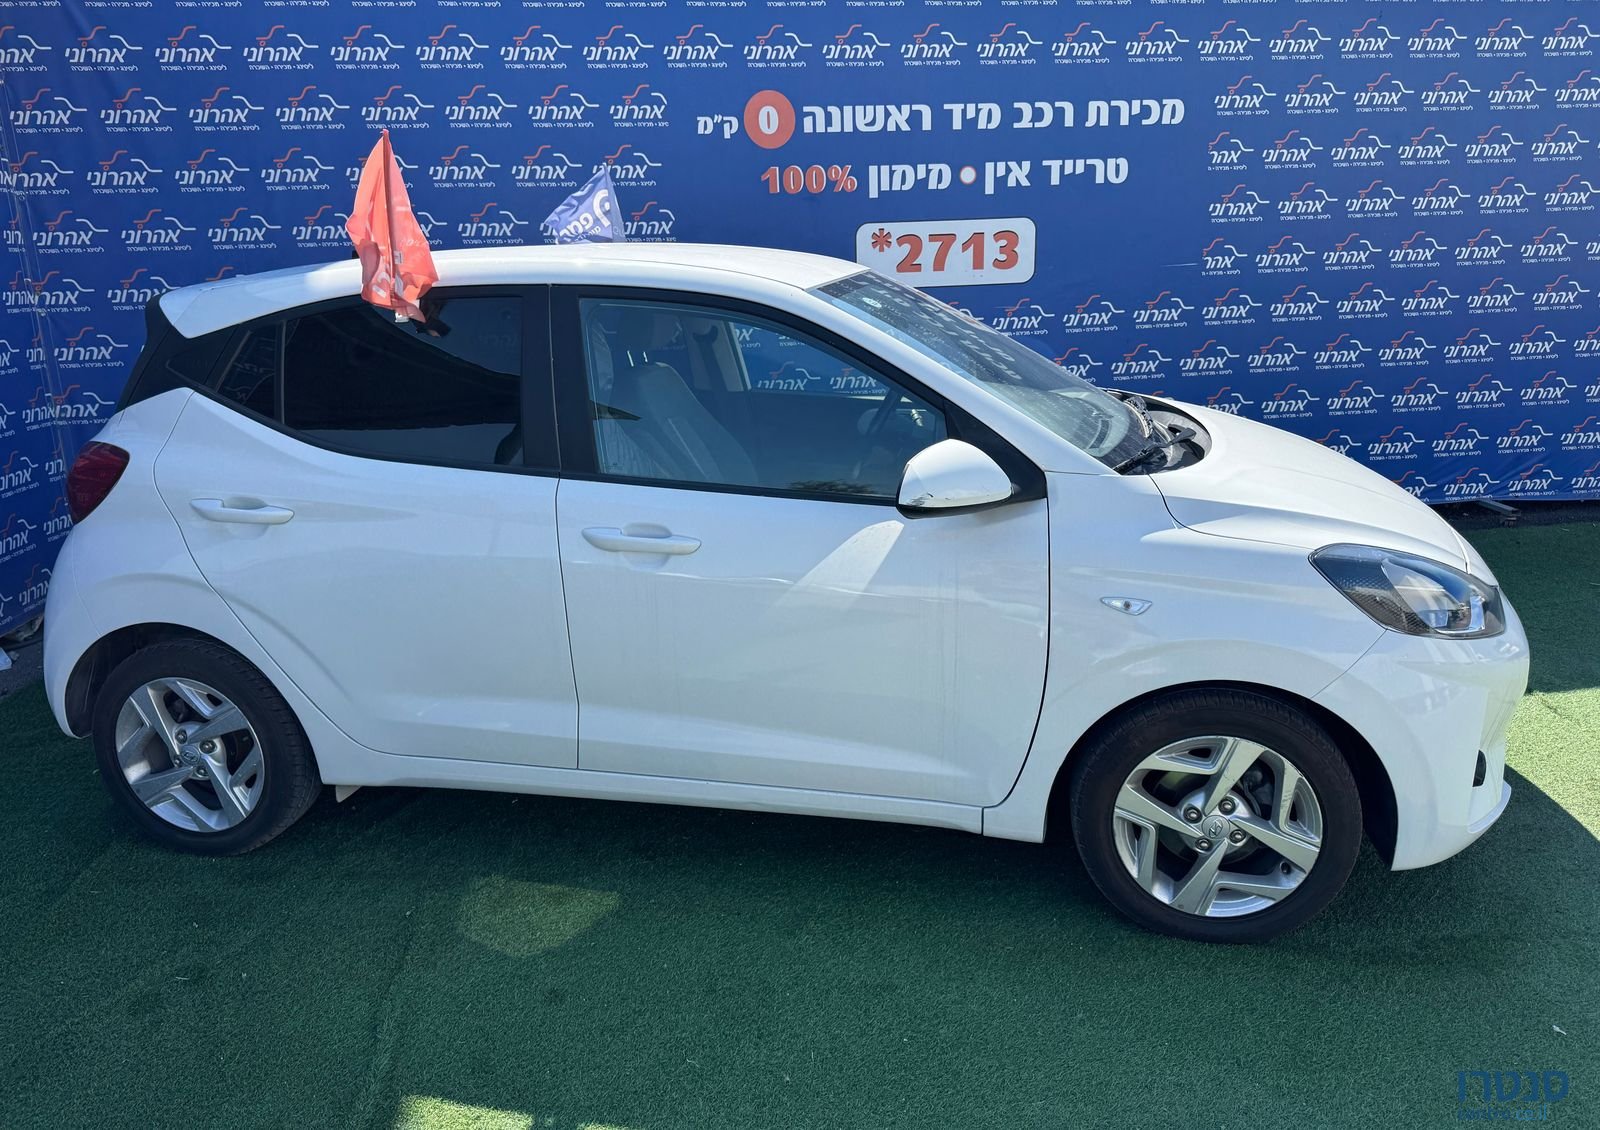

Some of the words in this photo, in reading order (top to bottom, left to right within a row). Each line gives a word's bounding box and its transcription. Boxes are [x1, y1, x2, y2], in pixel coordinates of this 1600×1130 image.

[976, 42, 1030, 58] אהרוני
[1051, 41, 1104, 57] אהרוני
[1125, 40, 1177, 56] אהרוני
[1197, 39, 1249, 55] אהרוני
[1268, 38, 1319, 53] אהרוני
[1338, 37, 1389, 52] אהרוני
[1407, 37, 1456, 51] אהרוני
[1474, 36, 1523, 51] אהרוני
[1541, 35, 1589, 50] אהרוני
[64, 47, 127, 64] אהרוני
[154, 47, 217, 63] אהרוני
[242, 46, 304, 63] אהרוני
[330, 46, 390, 62] אהרוני
[415, 45, 475, 61] אהרוני
[499, 46, 558, 62] אהרוני
[582, 45, 640, 61] אהרוני
[663, 44, 720, 61] אהרוני
[743, 44, 799, 60] אהרוני
[822, 44, 877, 60] אהרוני
[900, 43, 954, 59] אהרוני
[1213, 94, 1264, 109] אהרוני
[1284, 92, 1334, 108] אהרוני
[1353, 91, 1403, 106] אהרוני
[1420, 90, 1469, 105] אהרוני
[1487, 89, 1536, 104] אהרוני
[1554, 87, 1600, 102] אהרוני
[9, 109, 72, 126] אהרוני
[100, 108, 162, 125] אהרוני
[188, 107, 250, 124] אהרוני
[275, 106, 335, 122] אהרוני
[361, 105, 420, 122] אהרוני
[444, 105, 503, 121] אהרוני
[527, 104, 585, 121] אהרוני
[609, 104, 666, 120] אהרוני
[758, 105, 779, 135] 0
[802, 105, 932, 133] ראשונה
[943, 102, 1002, 130] מיד
[1012, 101, 1074, 129] רכב
[1084, 99, 1185, 128] מכירת
[1261, 147, 1311, 163] אהרוני
[1330, 146, 1380, 161] אהרוני
[1397, 144, 1446, 159] אהרוני
[1464, 143, 1512, 157] אהרוני
[1530, 141, 1578, 156] אהרוני
[86, 170, 148, 186] אהרוני
[174, 169, 235, 185] אהרוני
[260, 167, 320, 183] אהרוני
[428, 165, 487, 181] אהרוני
[511, 164, 568, 180] אהרוני
[761, 164, 858, 194] 100%
[984, 161, 1031, 195] אין
[1041, 158, 1129, 186] טרייד
[868, 163, 952, 199] מימון
[1277, 199, 1326, 214] אהרוני
[1345, 197, 1394, 212] אהרוני
[1411, 195, 1460, 210] אהרוני
[1477, 193, 1525, 208] אהרוני
[1543, 191, 1591, 206] אהרוני
[1208, 201, 1258, 217] אהרוני
[120, 228, 181, 244] אהרוני
[207, 226, 267, 243] אהרוני
[291, 224, 348, 240] אהרוני
[457, 222, 515, 237] אהרוני
[32, 230, 94, 247] אהרוני
[1322, 250, 1371, 265] אהרוני
[1388, 247, 1436, 262] אהרוני
[1454, 245, 1502, 260] אהרוני
[1520, 242, 1567, 257] אהרוני
[1255, 252, 1304, 267] אהרוני
[1336, 298, 1384, 313] אהרוני
[1401, 296, 1449, 311] אהרוני
[1466, 293, 1514, 308] אהרוני
[1532, 290, 1579, 305] אהרוני
[1132, 307, 1183, 323] אהרוני
[1201, 304, 1251, 319] אהרוני
[1269, 301, 1318, 316] אהרוני
[992, 315, 1043, 330] אהרוני
[1062, 311, 1113, 327] אהרוני
[53, 345, 114, 362] אהרוני
[1377, 346, 1425, 361] אהרוני
[1443, 343, 1490, 358] אהרוני
[1508, 340, 1555, 355] אהרוני
[1179, 355, 1228, 371] אהרוני
[1247, 352, 1295, 367] אהרוני
[1313, 349, 1361, 364] אהרוני
[1110, 359, 1160, 375] אהרוני
[829, 375, 877, 390] אהרוני
[1390, 392, 1437, 407] אהרוני
[1455, 389, 1502, 404] אהרוני
[1519, 386, 1566, 400] אהרוני
[1260, 399, 1309, 413] אהרוני
[1326, 395, 1374, 410] אהרוני
[1367, 441, 1414, 455] אהרוני
[1431, 437, 1478, 452] אהרוני
[1495, 434, 1542, 448] אהרוני
[1442, 481, 1489, 496] אהרוני
[1508, 478, 1552, 492] אהרוני
